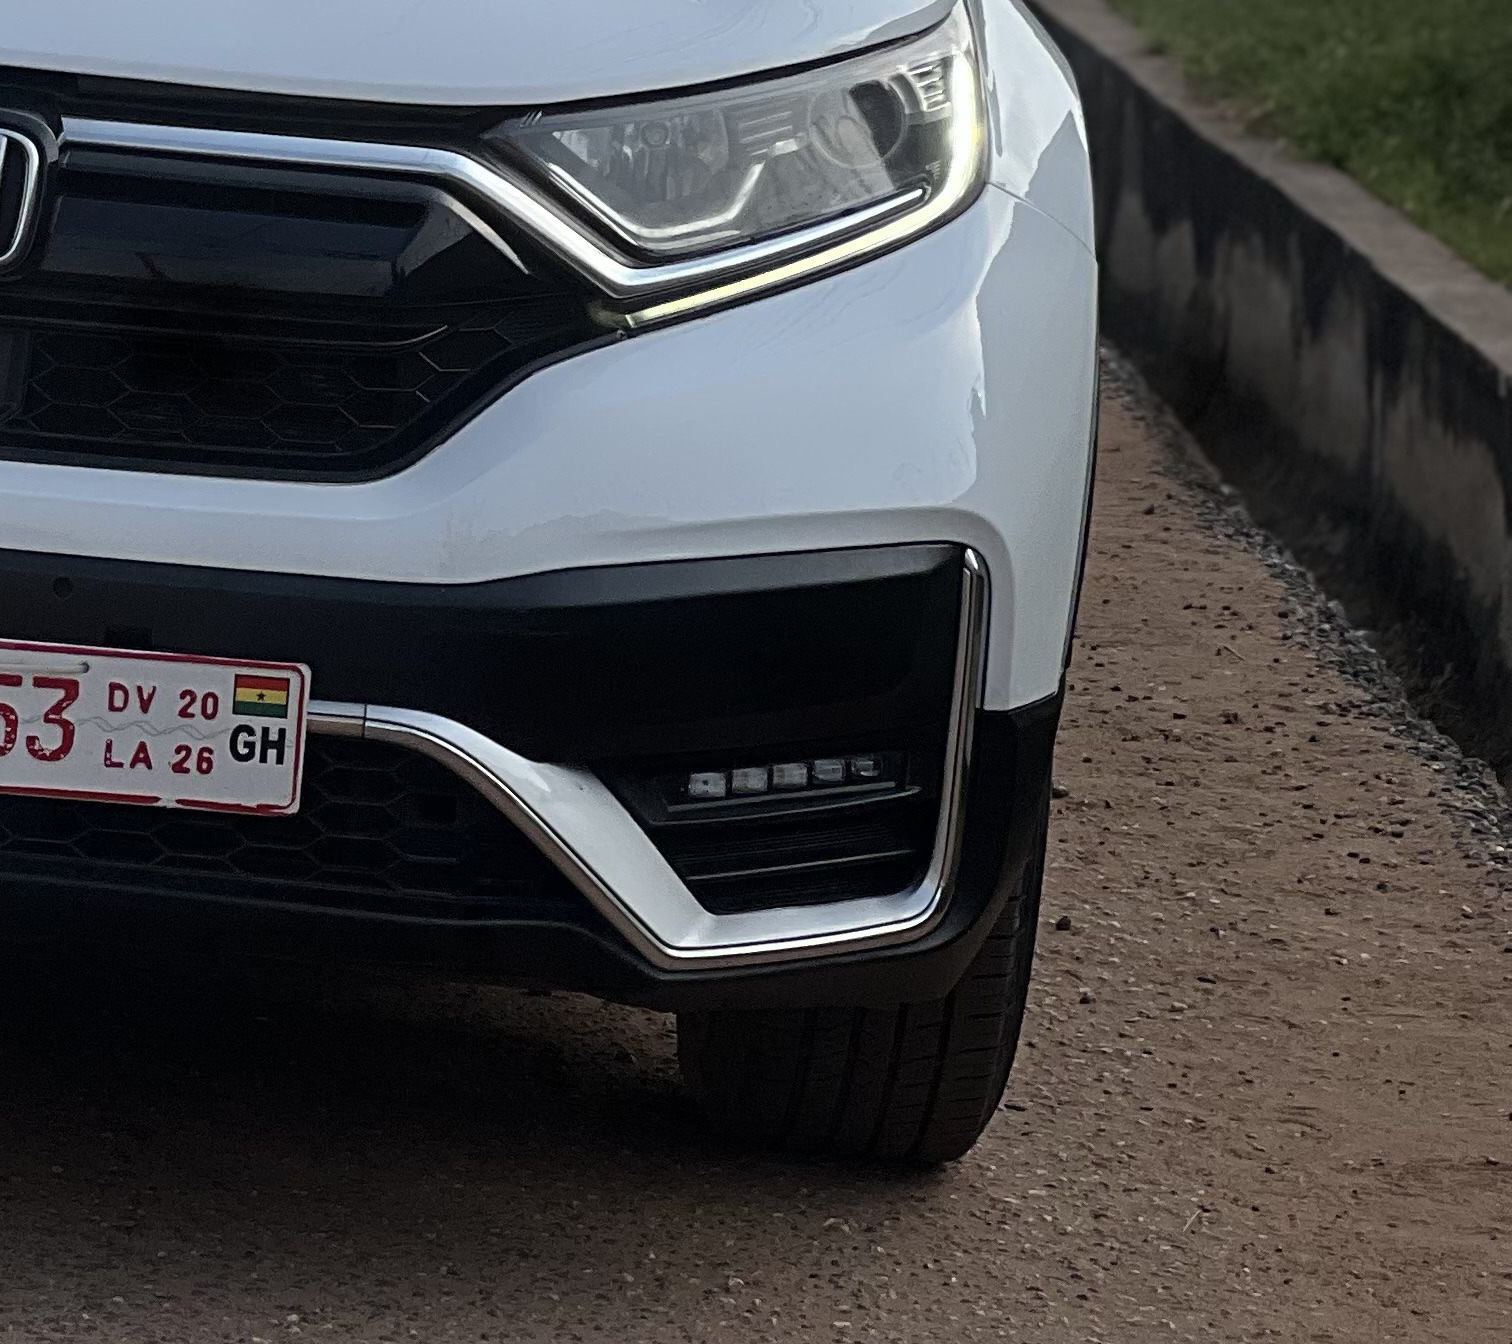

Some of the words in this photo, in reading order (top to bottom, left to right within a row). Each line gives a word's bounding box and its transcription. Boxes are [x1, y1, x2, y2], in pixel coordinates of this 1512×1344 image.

[107, 680, 157, 714] DV
[177, 688, 219, 720] 20
[103, 738, 153, 770] LA
[171, 743, 214, 775] 26
[229, 723, 286, 766] GH
